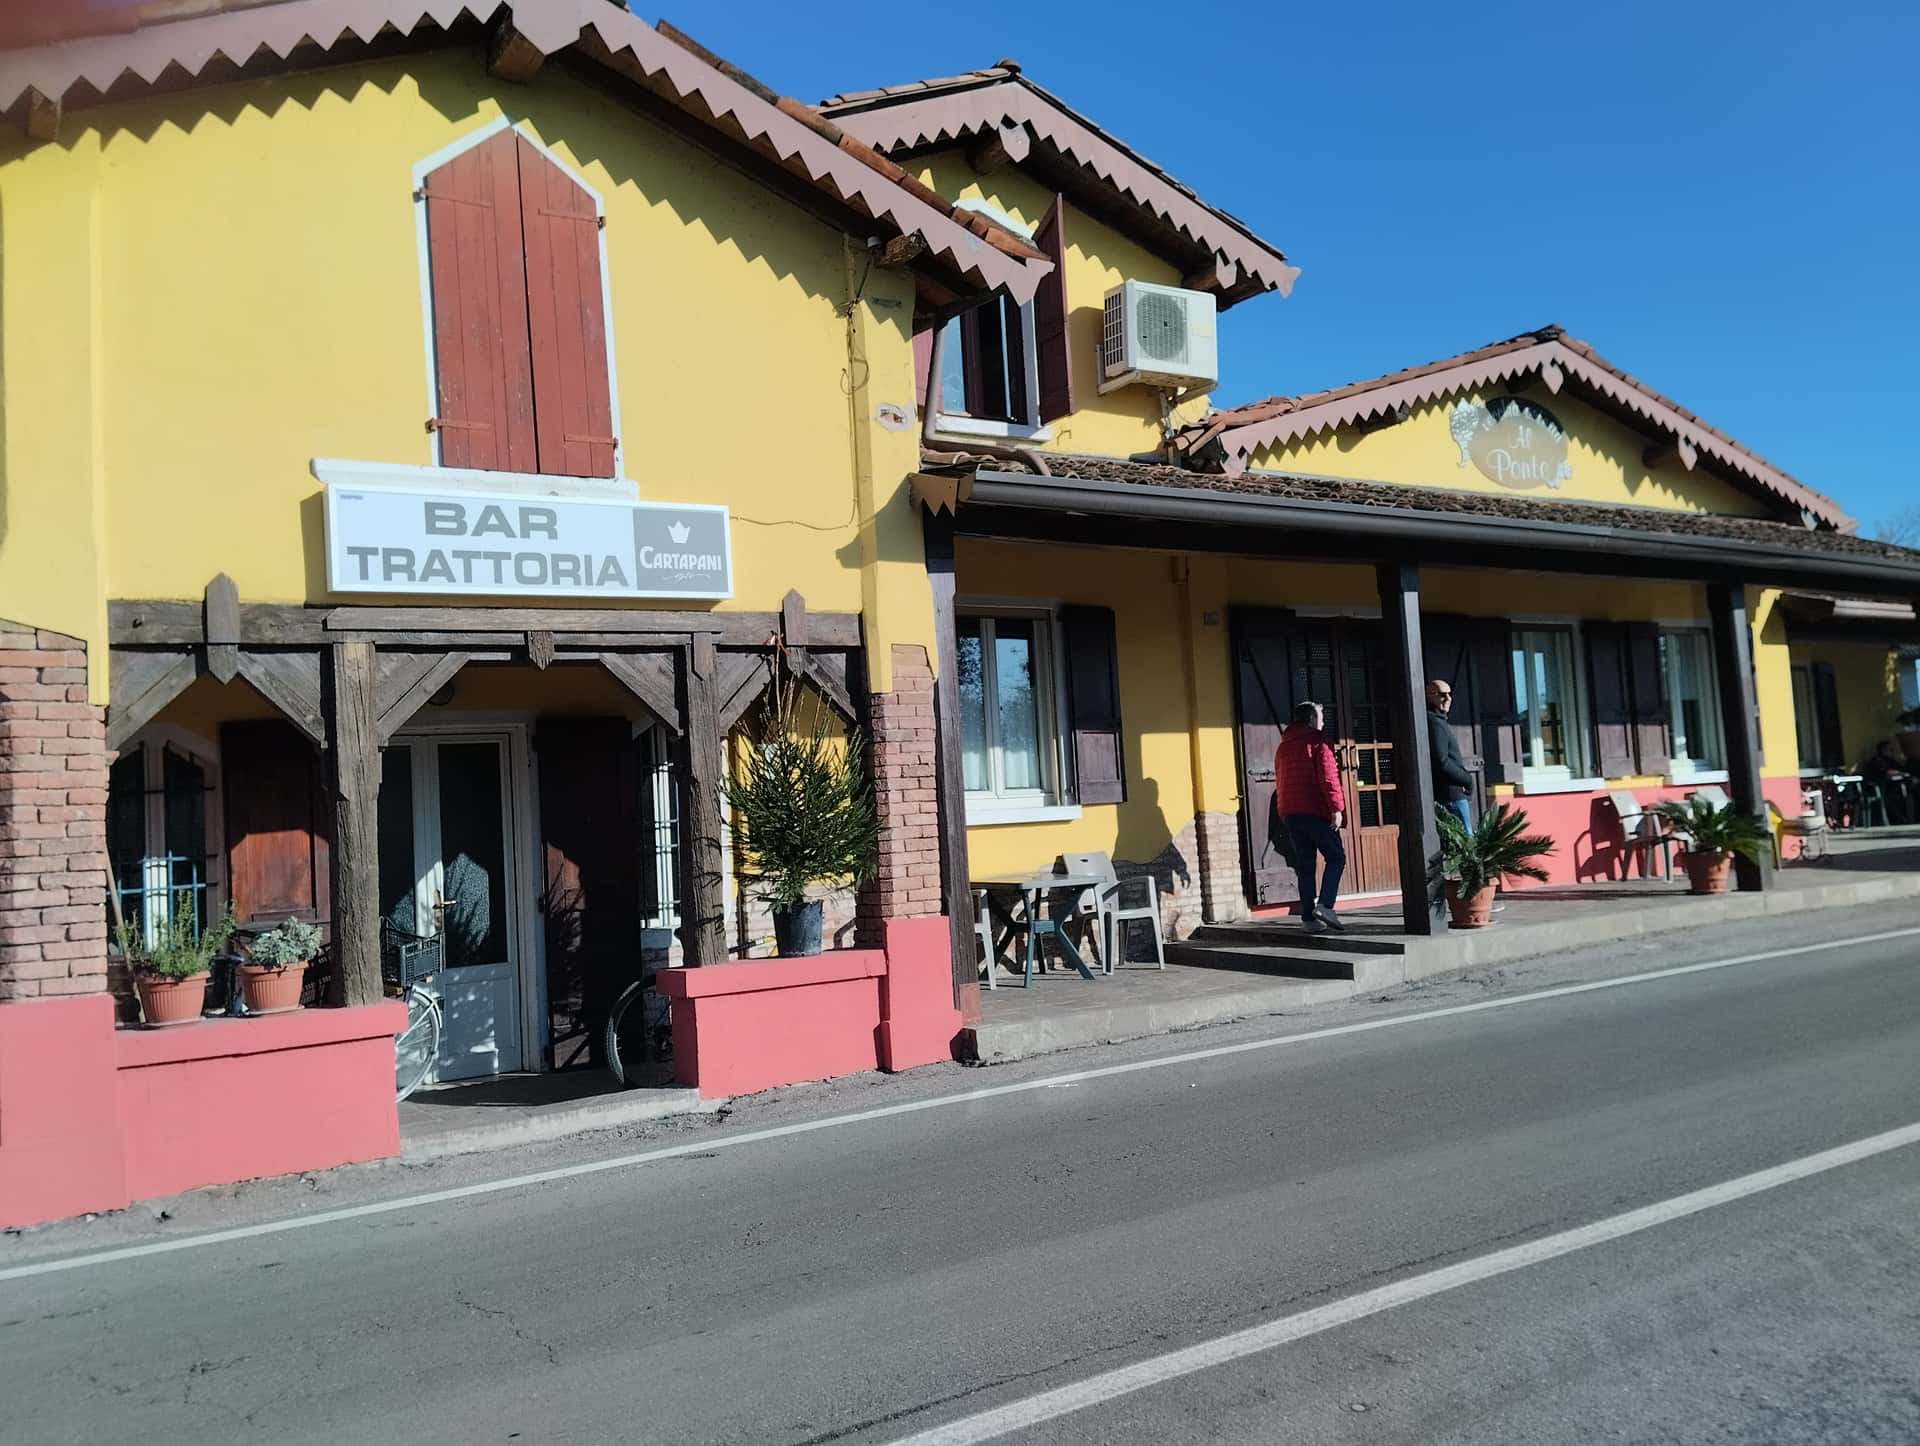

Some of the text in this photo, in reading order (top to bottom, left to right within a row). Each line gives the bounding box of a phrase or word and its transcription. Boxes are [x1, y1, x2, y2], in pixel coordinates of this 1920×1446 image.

[1488, 448, 1549, 481] Ponte
[424, 501, 558, 540] BAR
[347, 546, 629, 587] TRATTORIA
[639, 545, 722, 571] CARTAPANI
